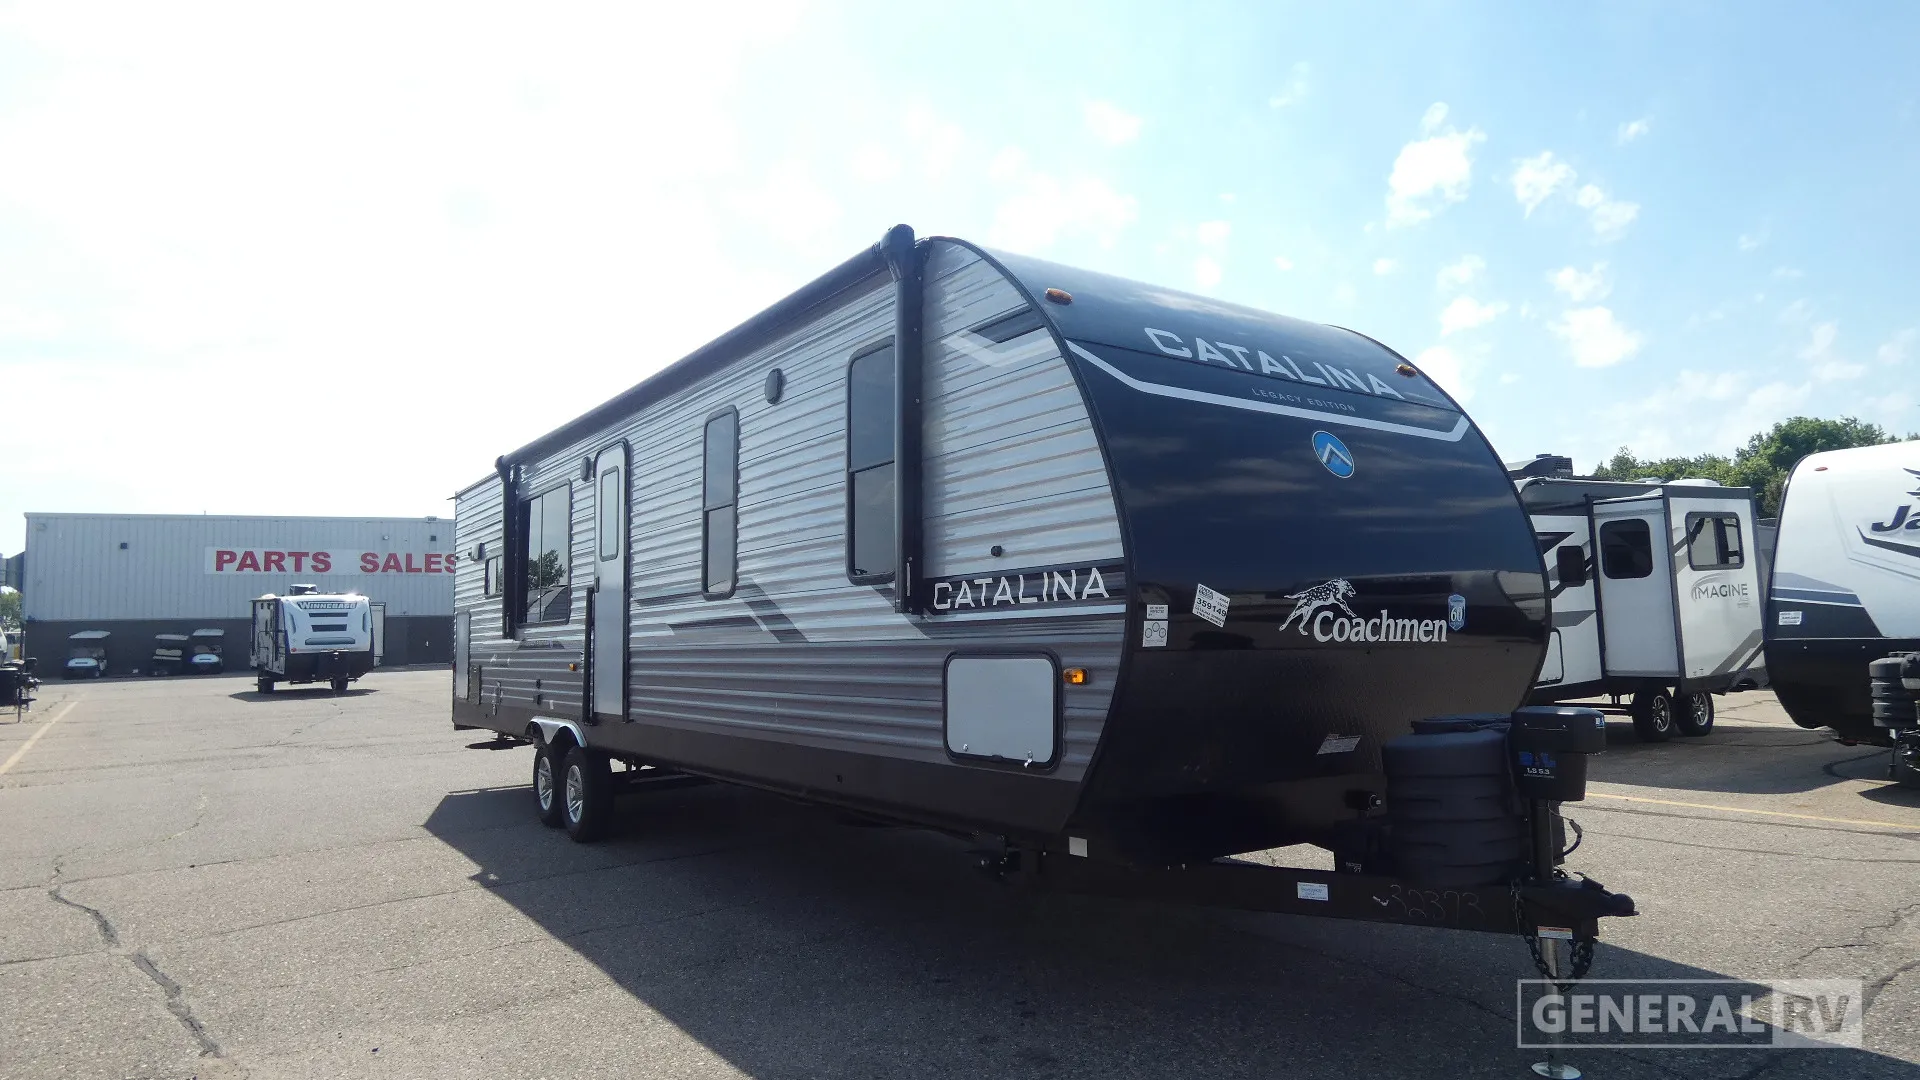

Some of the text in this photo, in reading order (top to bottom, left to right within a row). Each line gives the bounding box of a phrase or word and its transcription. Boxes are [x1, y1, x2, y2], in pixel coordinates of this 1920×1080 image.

[1144, 327, 1405, 400] CATALINA
[1251, 388, 1356, 412] LEGACY EDITION
[215, 550, 332, 573] PARTS
[933, 567, 1109, 611] CATALINA
[1693, 584, 1748, 600] IMAGINE
[300, 601, 356, 610] WINNEBAGO
[1196, 597, 1227, 617] 359149
[1451, 606, 1463, 622] 60
[1313, 609, 1447, 643] Coachmen
